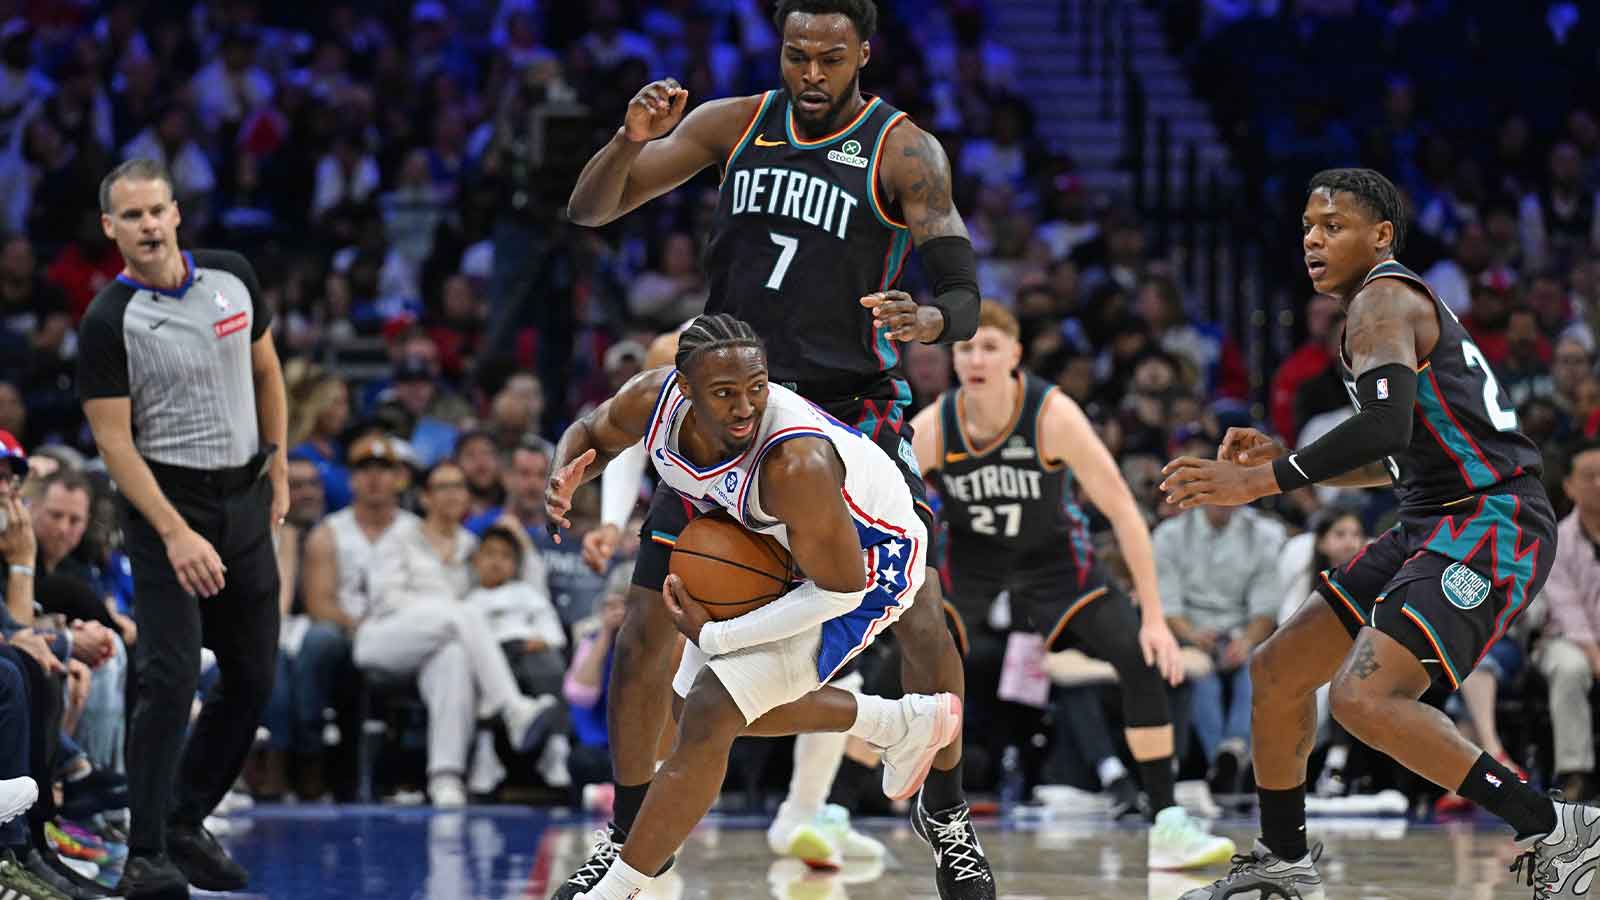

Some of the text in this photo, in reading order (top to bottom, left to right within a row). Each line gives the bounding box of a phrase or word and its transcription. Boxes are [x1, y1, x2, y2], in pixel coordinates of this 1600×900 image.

[732, 167, 859, 240] DETROIT
[765, 232, 799, 291] 7
[968, 502, 1022, 536] 27
[1448, 571, 1479, 602] PISTONS
[1456, 564, 1487, 593] DETROIT
